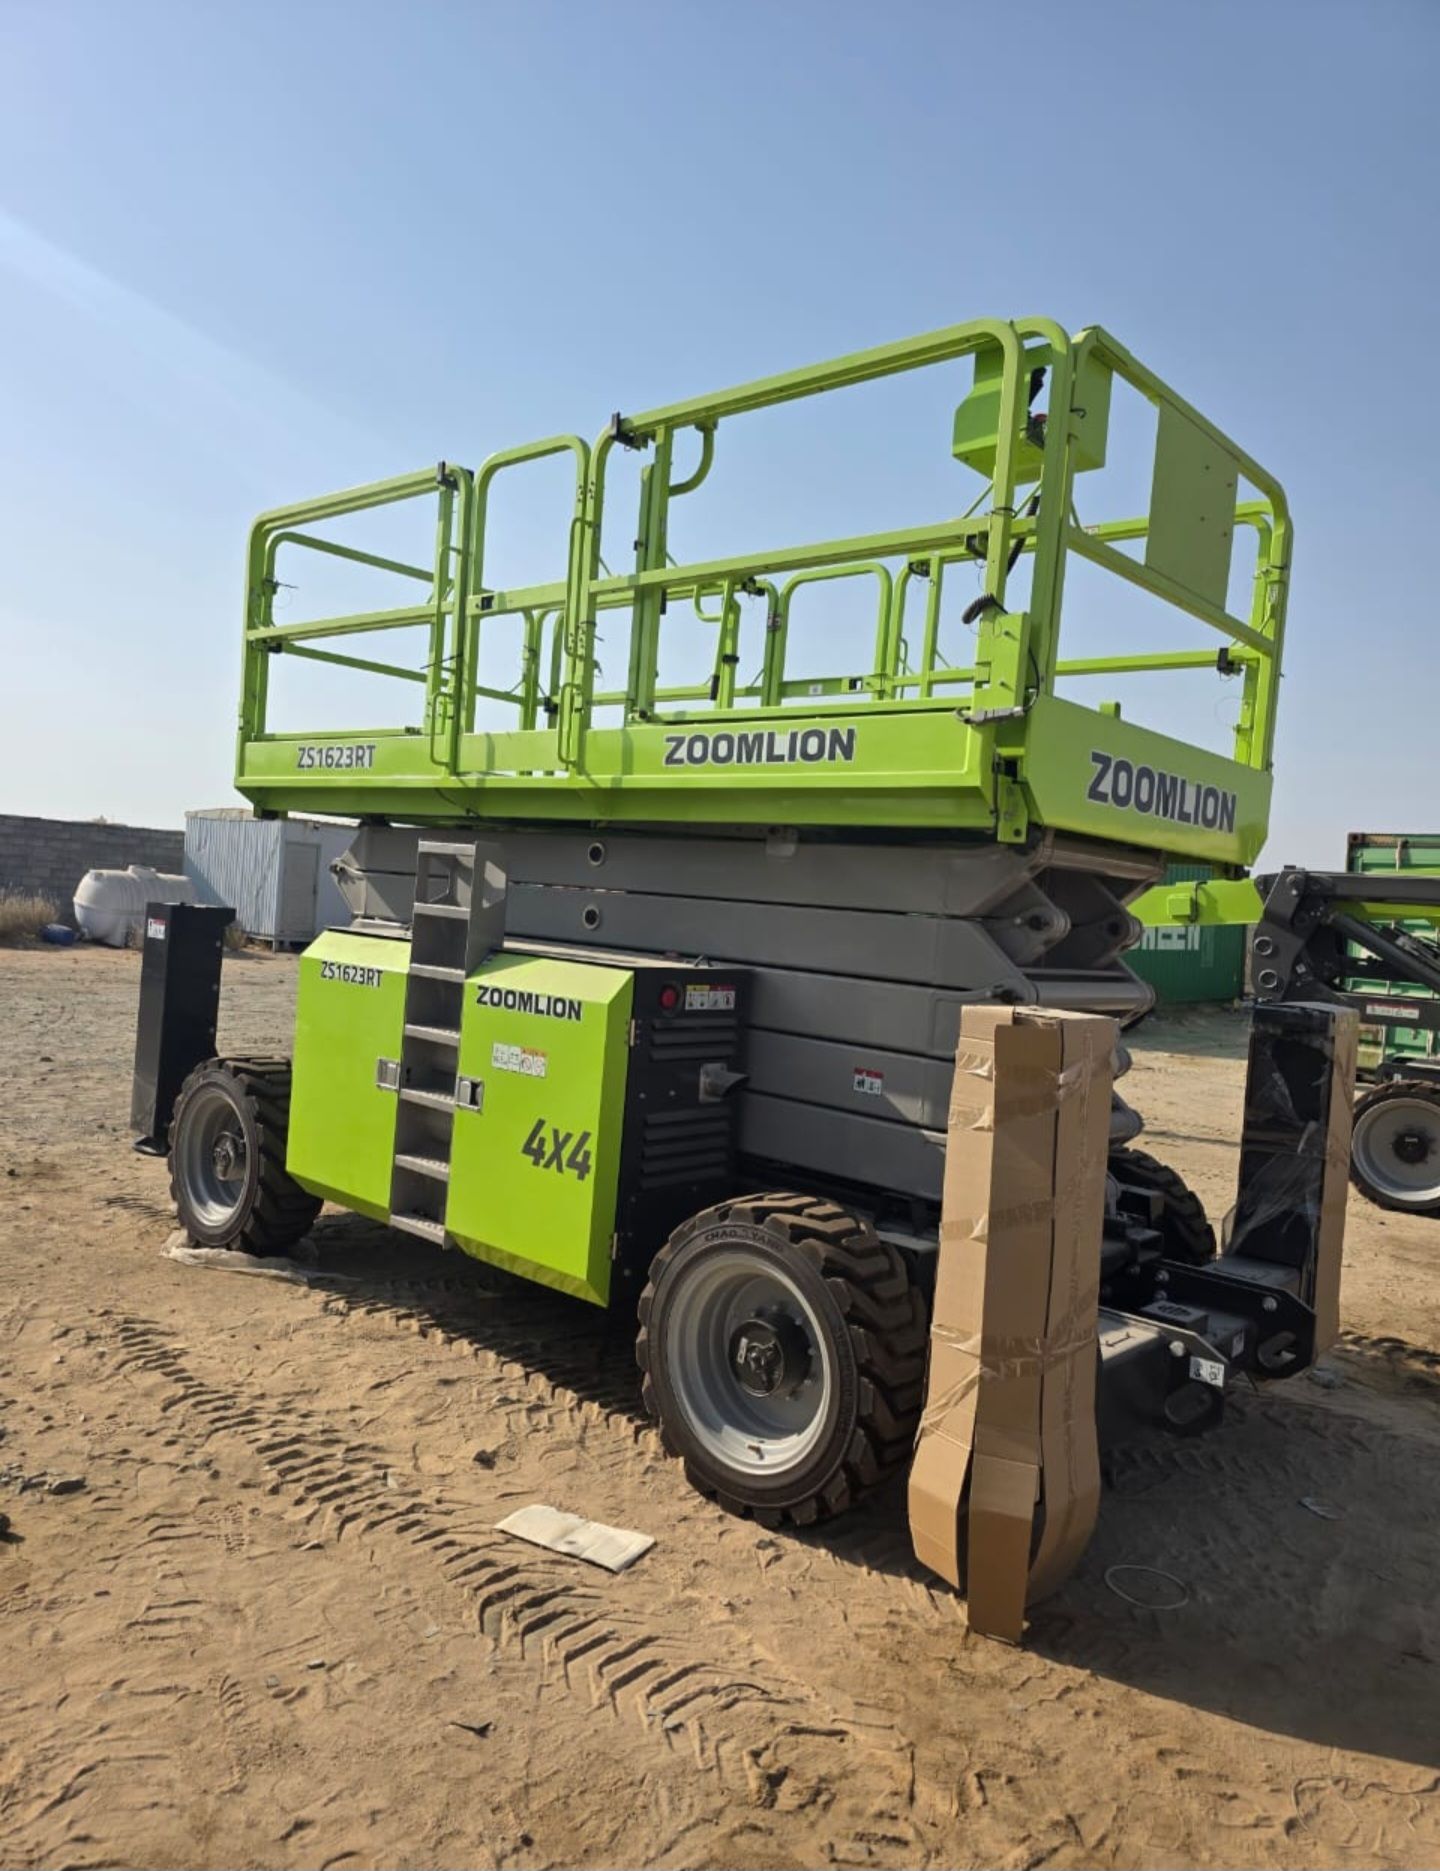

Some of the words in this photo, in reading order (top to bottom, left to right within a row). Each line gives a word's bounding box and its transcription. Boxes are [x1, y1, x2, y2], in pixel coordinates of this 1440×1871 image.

[297, 744, 376, 769] ZS1623RT
[664, 727, 856, 766] ZOOMLION
[1087, 751, 1237, 834] ZOOMLION
[321, 960, 383, 988] ZS1623RT
[476, 984, 582, 1021] ZOOMLION
[521, 1118, 592, 1181] 4X4
